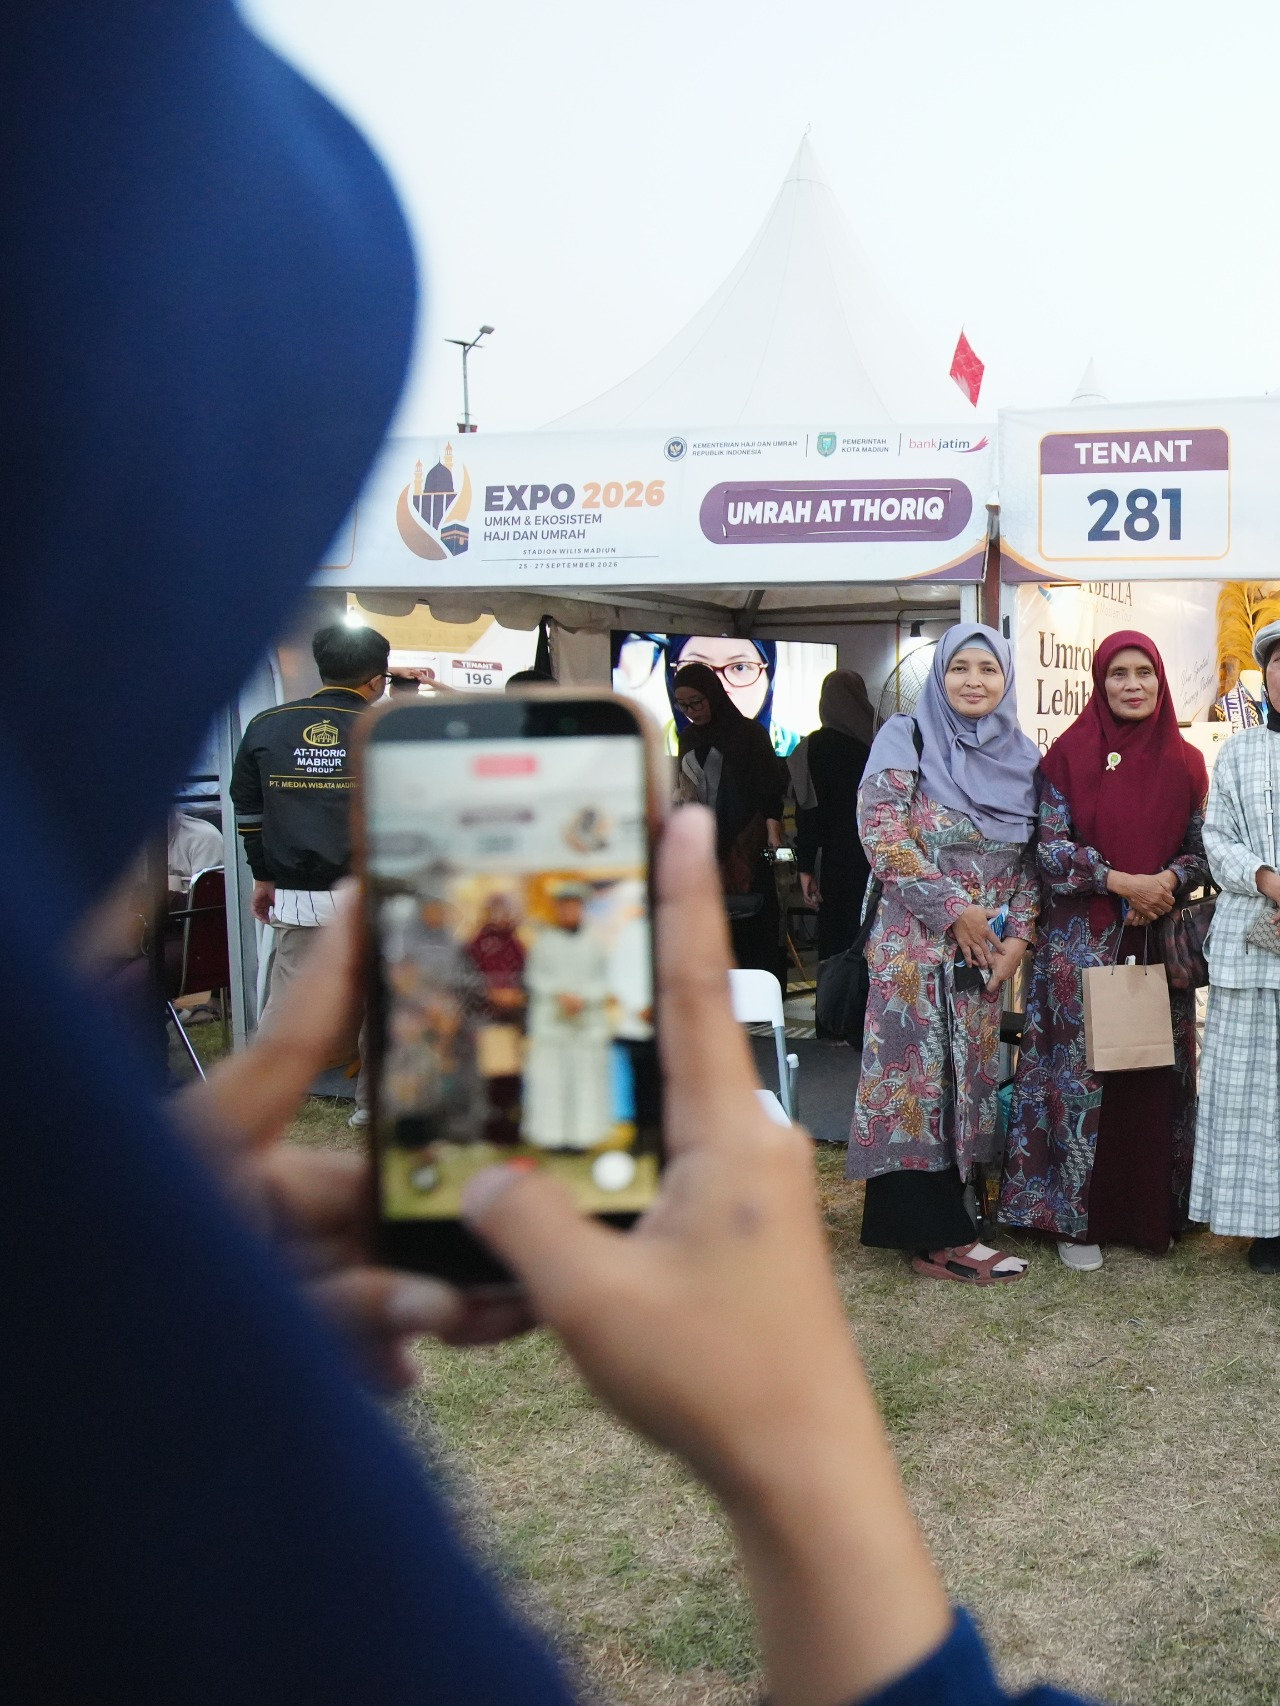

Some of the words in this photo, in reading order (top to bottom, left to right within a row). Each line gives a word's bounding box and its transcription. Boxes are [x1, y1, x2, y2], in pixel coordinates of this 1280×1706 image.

[1074, 440, 1193, 465] TENANT
[484, 483, 576, 512] EXPO
[582, 479, 666, 510] 2026
[727, 501, 811, 526] UMRAH
[814, 500, 846, 523] AT
[850, 496, 945, 522] THORIQ
[1087, 488, 1182, 541] 281
[484, 515, 521, 527] UMKM
[524, 515, 532, 526] &
[534, 513, 602, 526] EKOSISTEM
[484, 531, 510, 542] HAJI
[513, 530, 538, 541] DAN
[541, 529, 586, 540] UMRAH
[461, 661, 494, 670] TENANT
[465, 673, 493, 686] 196
[293, 748, 347, 757] AT-THORIQ
[297, 758, 342, 767] MABRUR
